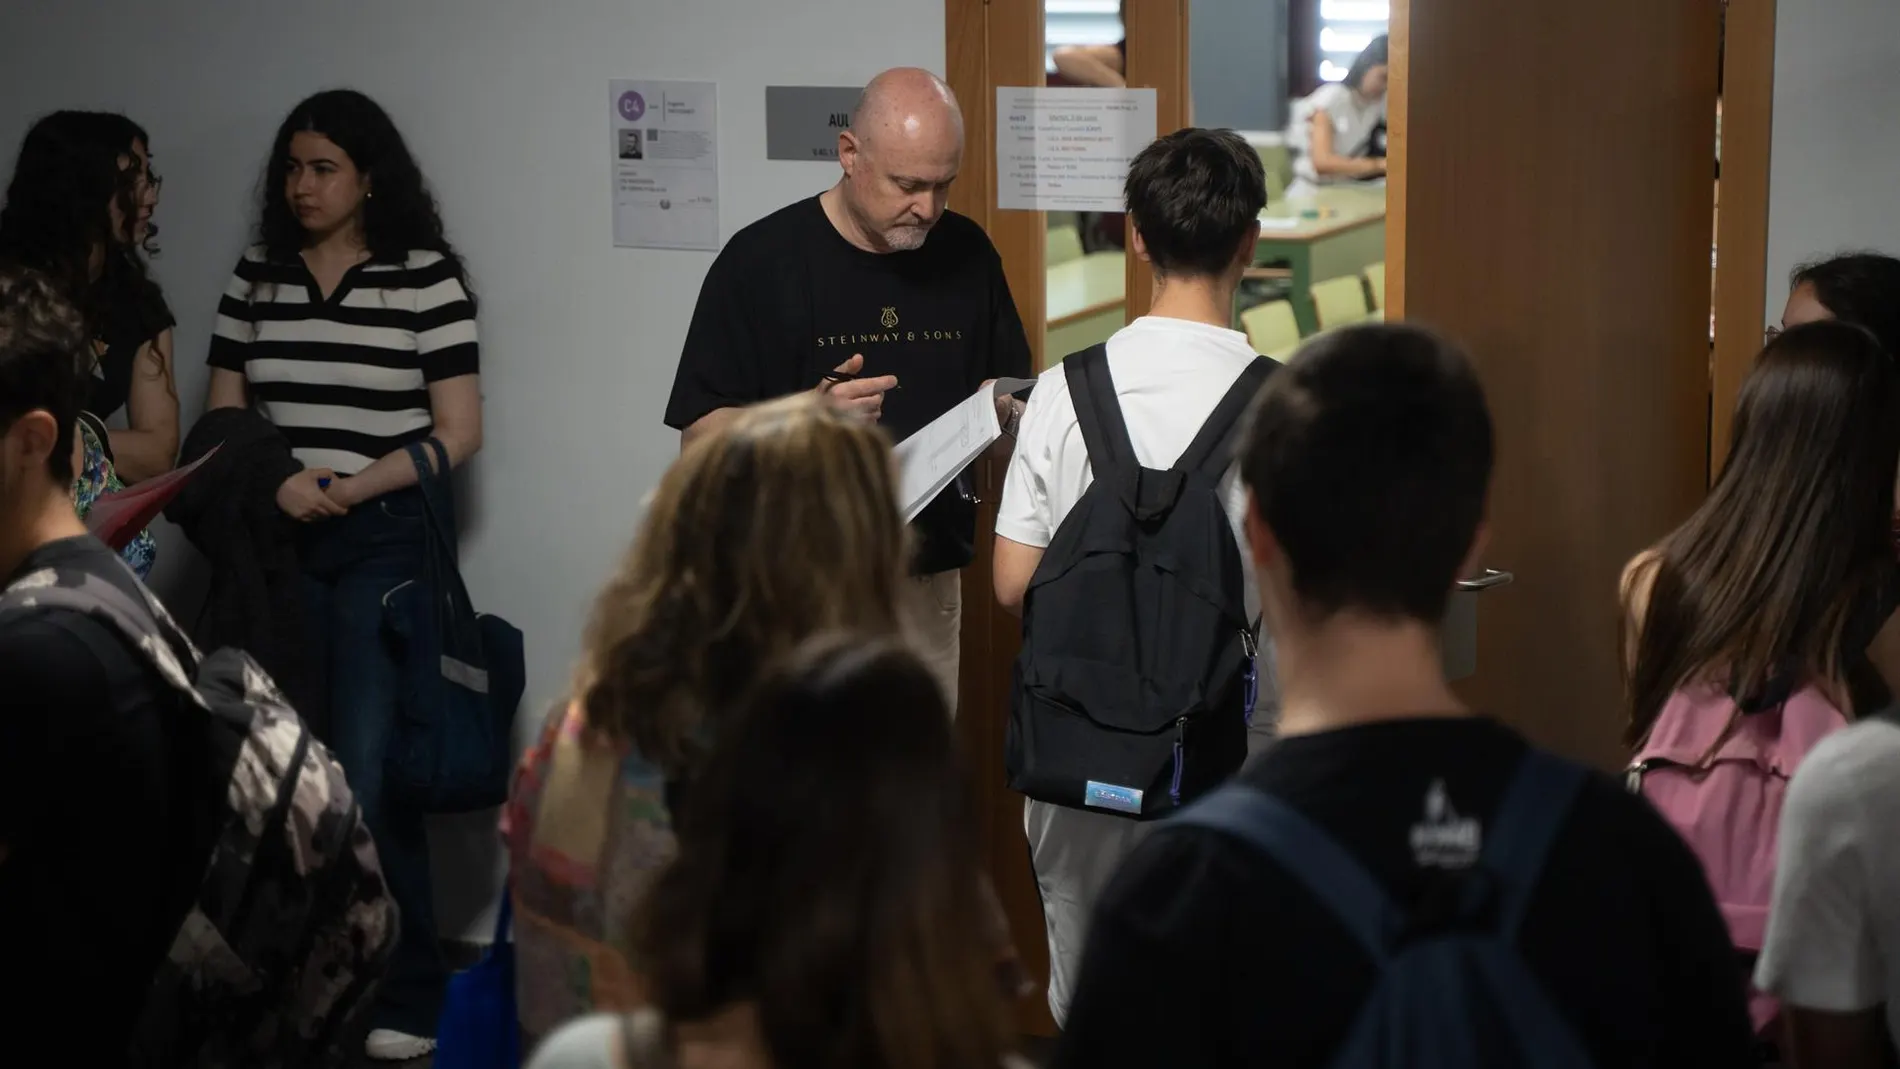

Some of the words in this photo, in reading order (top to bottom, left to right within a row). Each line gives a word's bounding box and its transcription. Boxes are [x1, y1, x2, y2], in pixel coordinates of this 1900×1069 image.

[828, 112, 850, 128] AUL
[817, 332, 900, 347] STEINWAY
[907, 331, 916, 342] &
[923, 330, 963, 341] SONS
